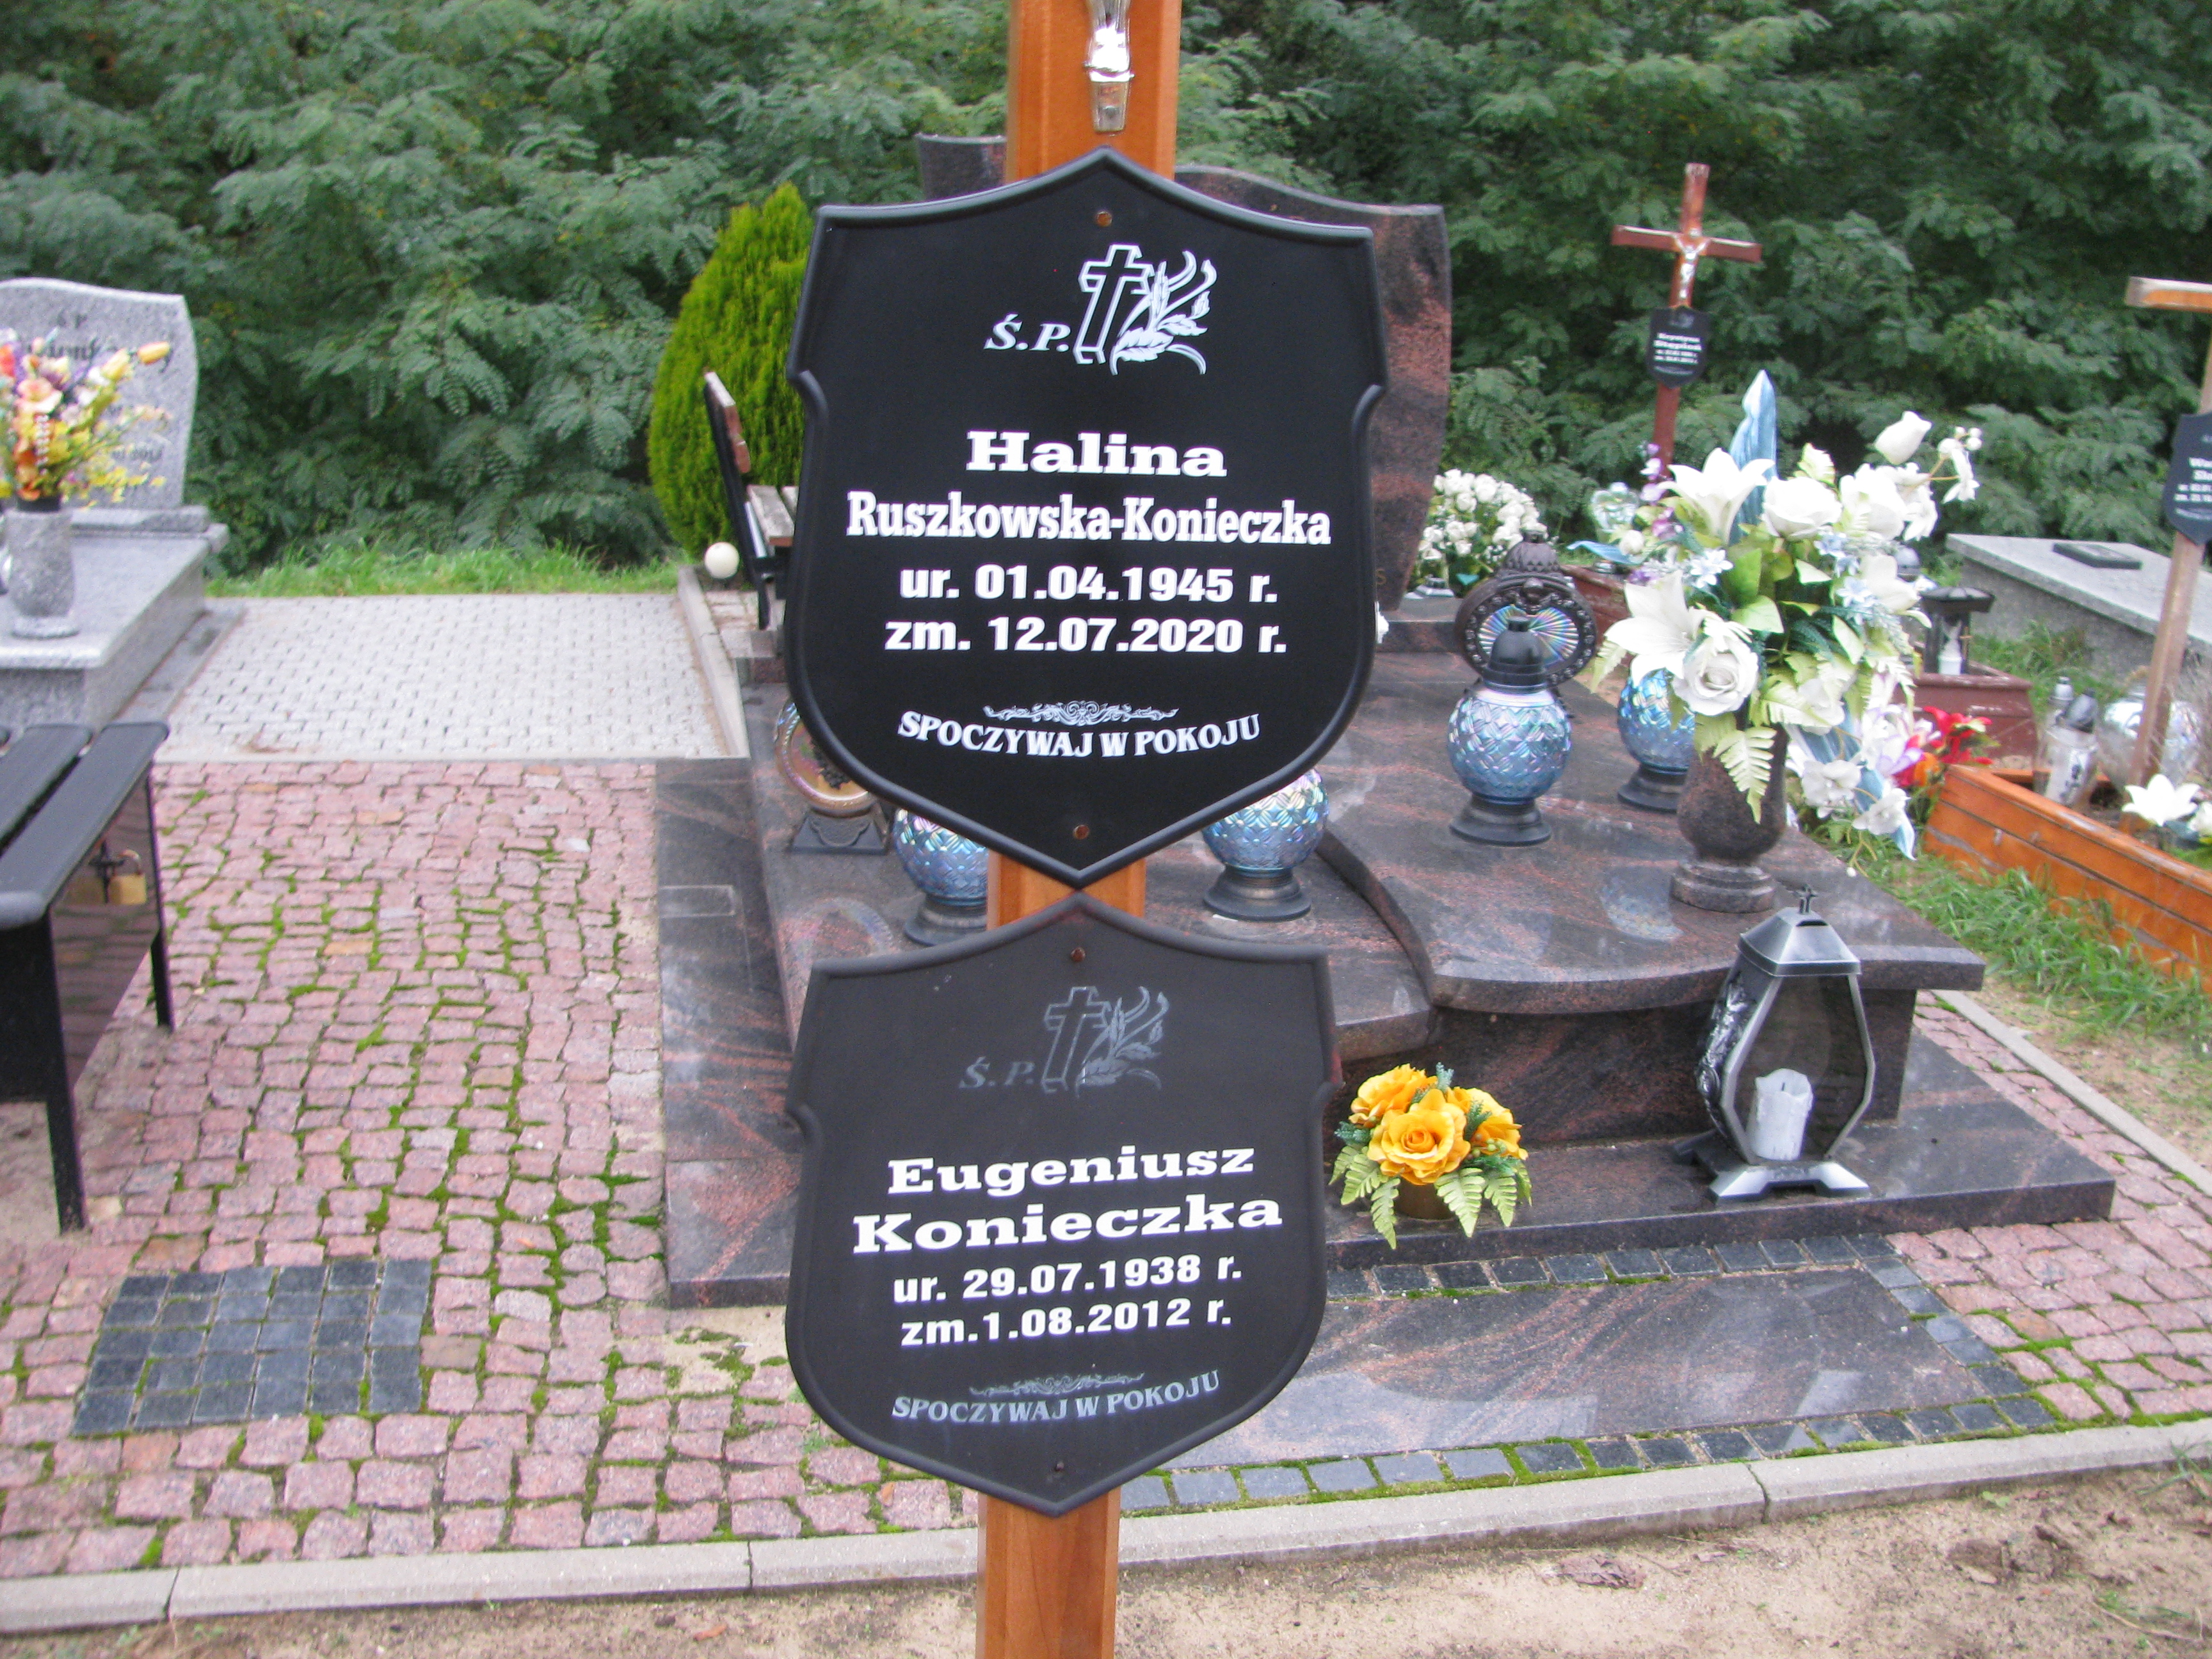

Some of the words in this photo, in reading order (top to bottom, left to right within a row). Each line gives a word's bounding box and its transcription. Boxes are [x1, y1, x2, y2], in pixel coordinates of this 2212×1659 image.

[966, 430, 1228, 477] Halina
[846, 490, 1332, 545] Ruszkowska-Konieczka
[900, 569, 959, 598] ur.
[975, 563, 1234, 603] 01.04.1945
[1249, 575, 1278, 603] r.
[885, 621, 971, 651] zm.
[988, 616, 1244, 653] 12.07.2020
[1258, 625, 1286, 653] r.
[897, 710, 1094, 758] SPOCZYWAJ
[1099, 732, 1129, 757] W
[1134, 713, 1260, 756] POKOJU
[888, 1145, 1254, 1198] Eugeniusz
[853, 1193, 1283, 1254] Konieczka
[894, 1276, 947, 1304] ur.
[962, 1254, 1201, 1299] 29.07.1938
[1217, 1256, 1242, 1280] r.
[1207, 1299, 1231, 1325] r.
[891, 1395, 1068, 1424] SPOCZYWAJ
[1073, 1395, 1102, 1420] W
[1107, 1369, 1220, 1415] POKOJU
